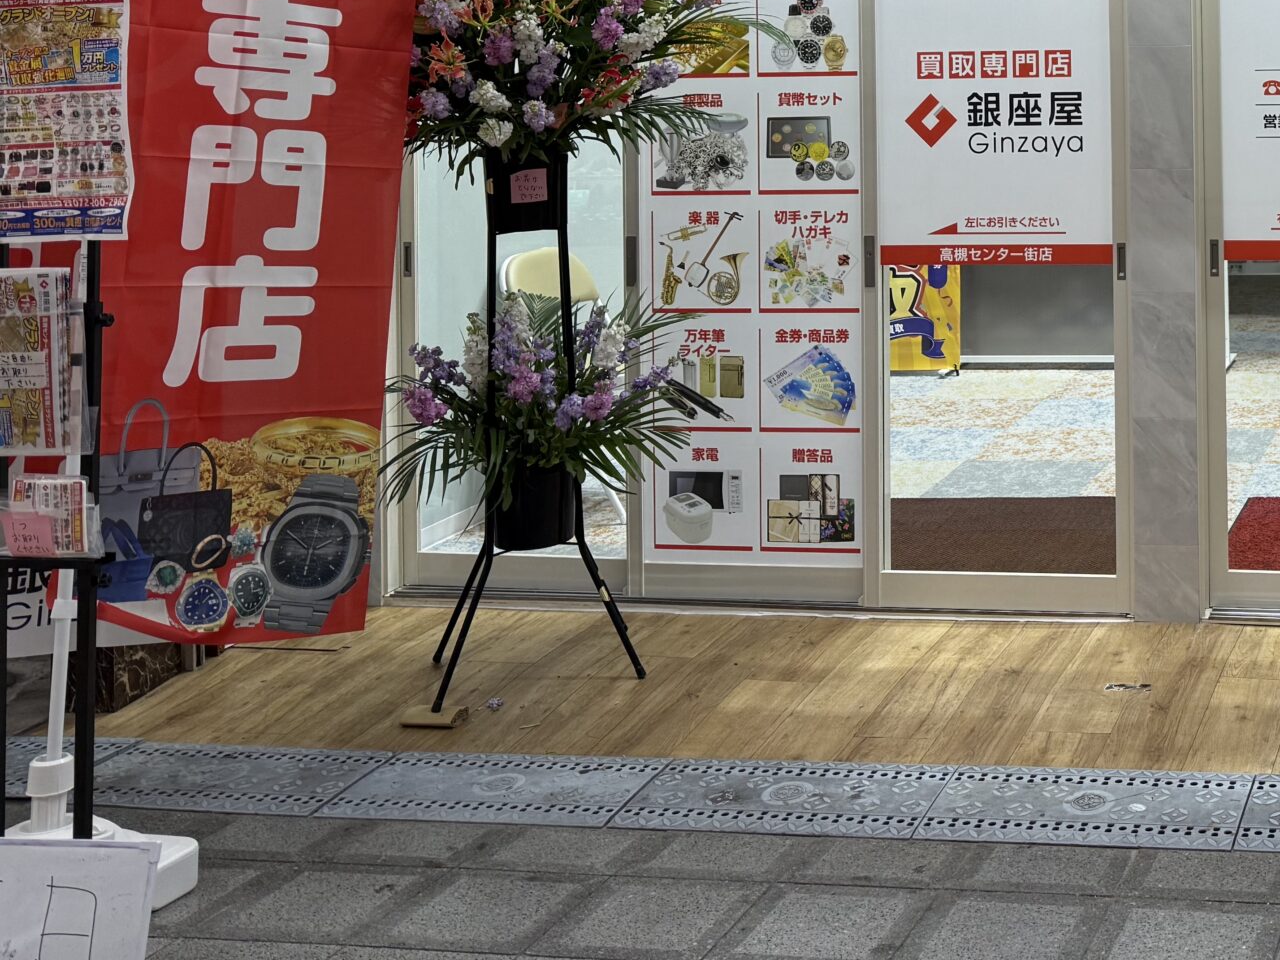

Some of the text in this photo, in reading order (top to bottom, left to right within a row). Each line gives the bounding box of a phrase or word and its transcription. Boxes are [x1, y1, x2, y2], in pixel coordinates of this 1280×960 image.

[918, 51, 1071, 78] 買取専門店
[777, 92, 843, 107] 貨幣セット
[966, 91, 1084, 128] 銀座屋
[967, 131, 1084, 158] Ginzaya
[688, 211, 720, 226] 楽器
[774, 210, 849, 225] 切手・テレカ
[964, 216, 1060, 229] 左にお引きください
[791, 225, 832, 239] ハガキ
[938, 246, 1054, 263] 高槻センター街店
[683, 328, 726, 343] 万年筆
[774, 328, 850, 344] 金券・商品券
[678, 344, 731, 358] ライター
[691, 447, 719, 462] 家電
[791, 448, 833, 463] 贈答品
